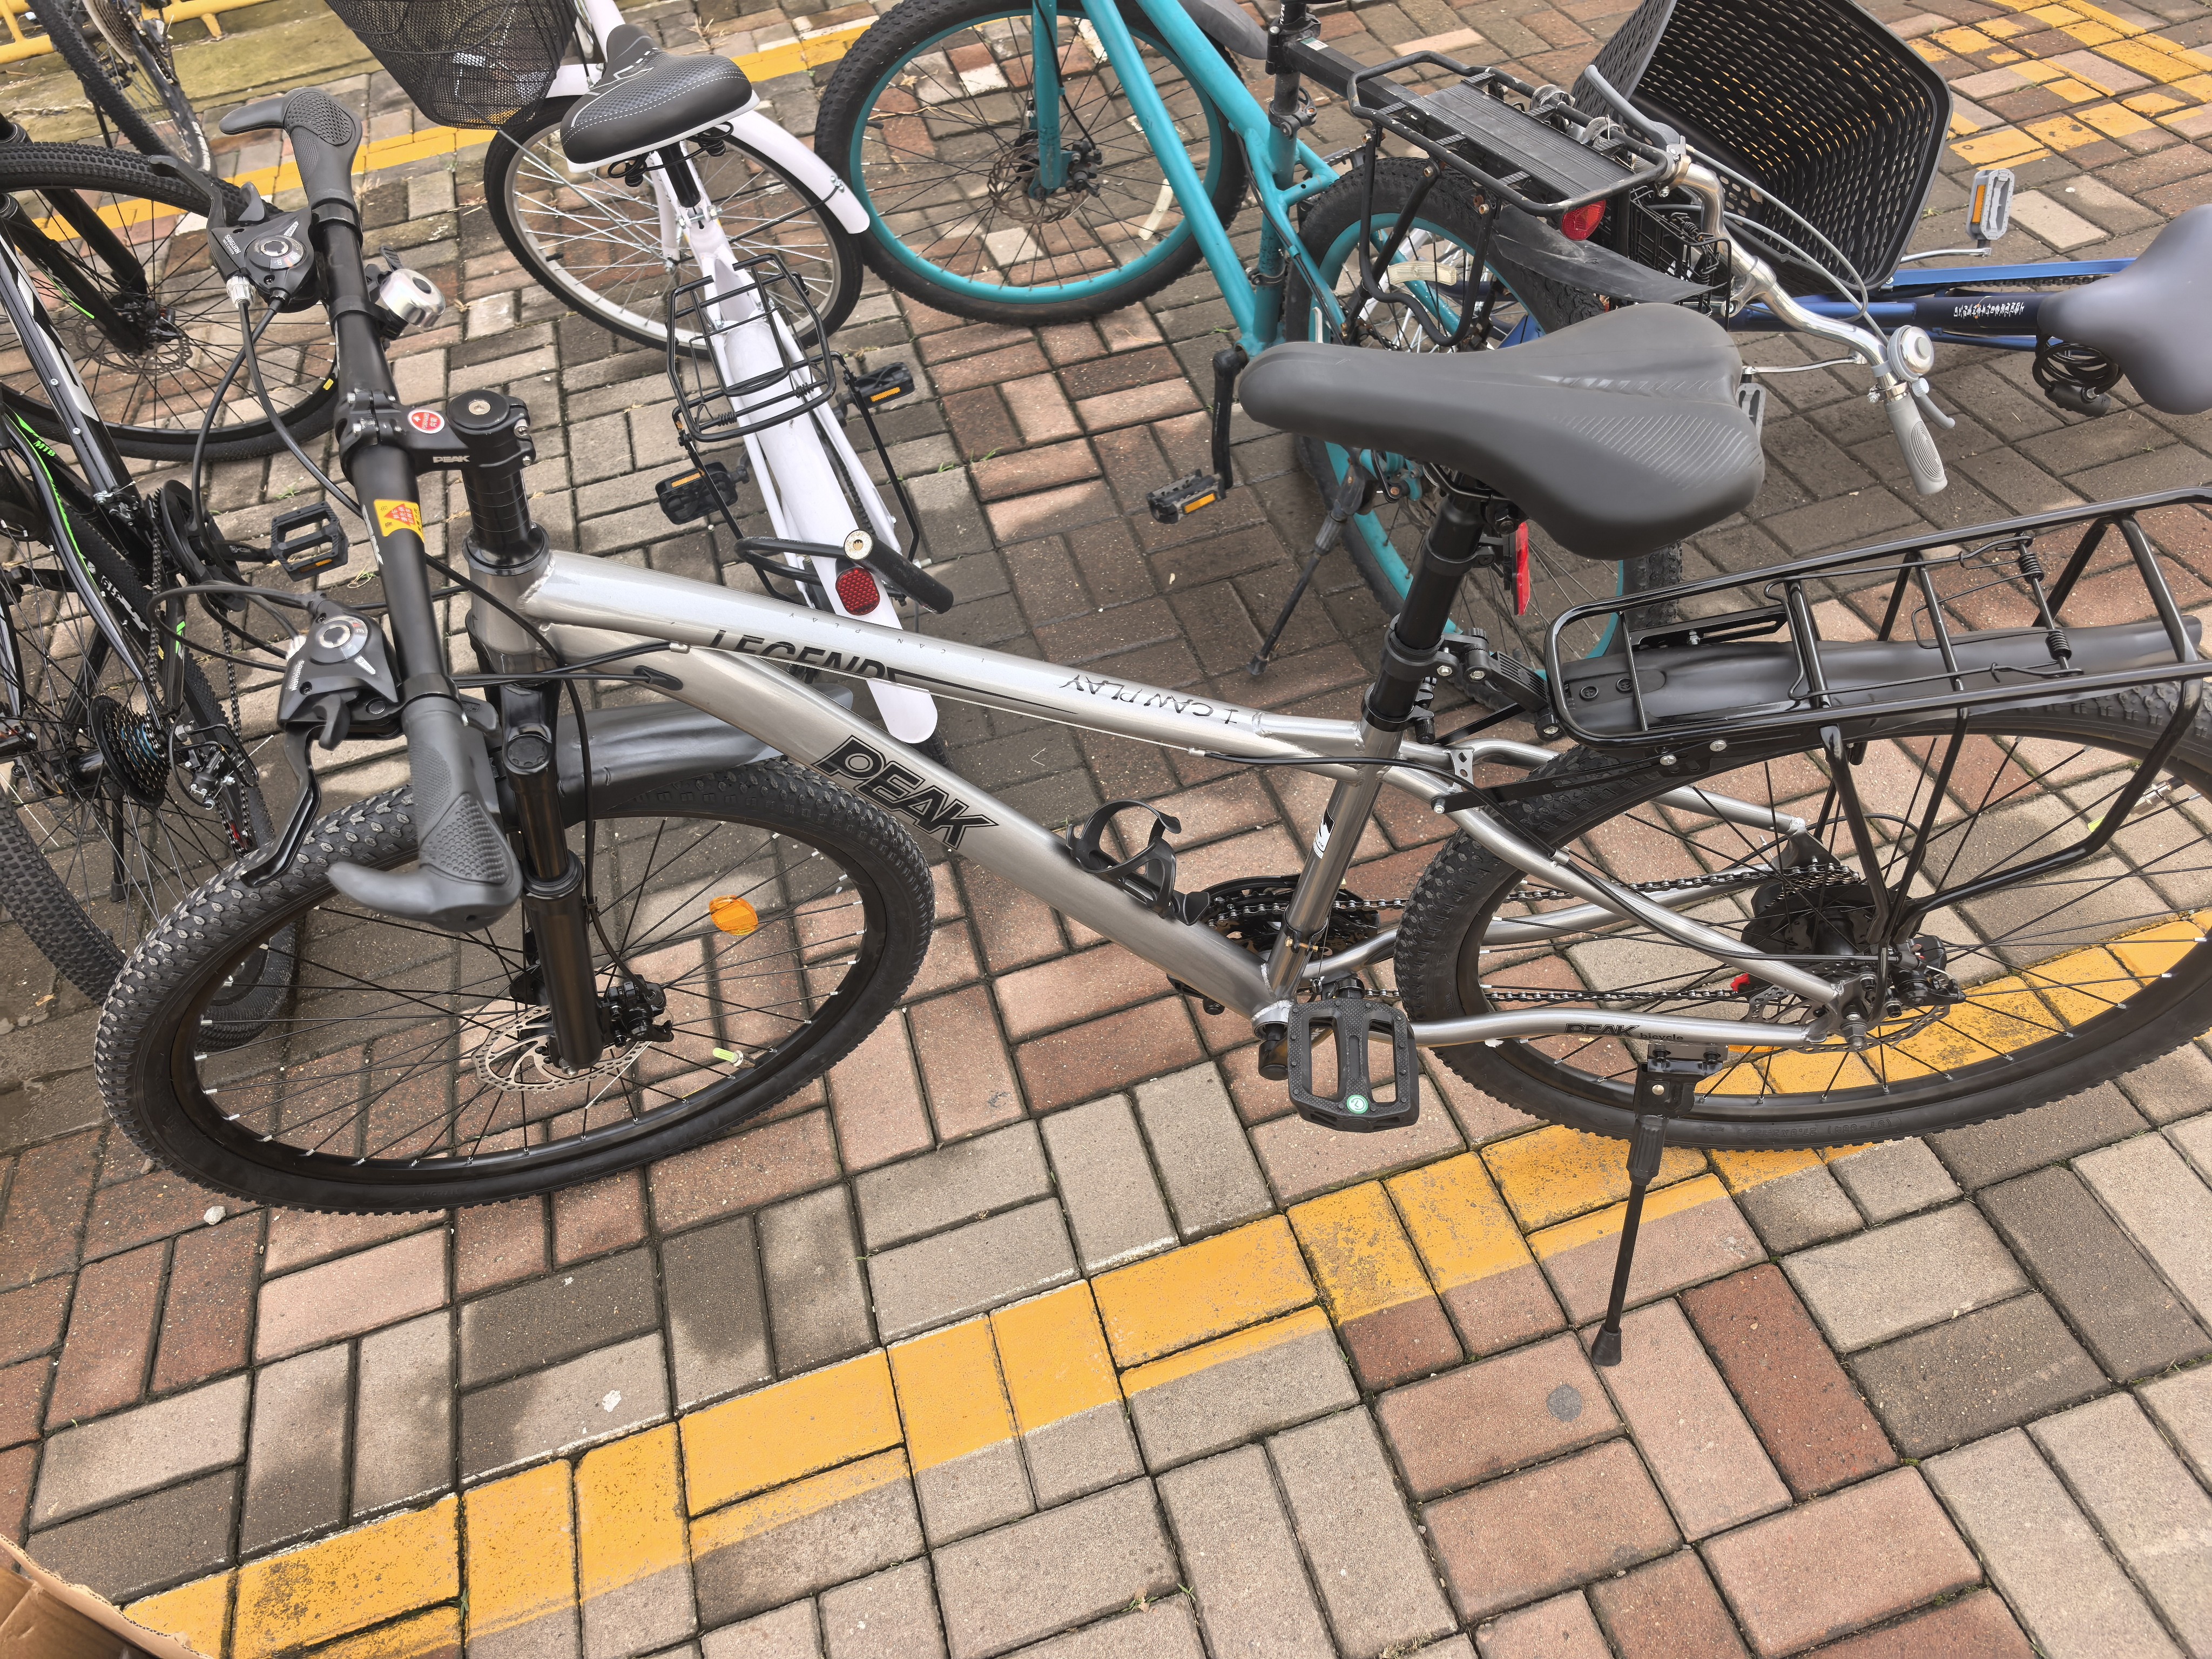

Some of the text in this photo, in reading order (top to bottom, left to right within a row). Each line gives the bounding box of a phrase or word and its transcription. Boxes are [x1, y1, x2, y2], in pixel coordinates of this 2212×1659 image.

[33, 440, 56, 457] MTB
[433, 455, 470, 463] PEAK
[1058, 674, 1143, 703] PLAY
[810, 734, 1000, 851] PEAK
[1564, 1023, 1684, 1041] PEAK bicycle
